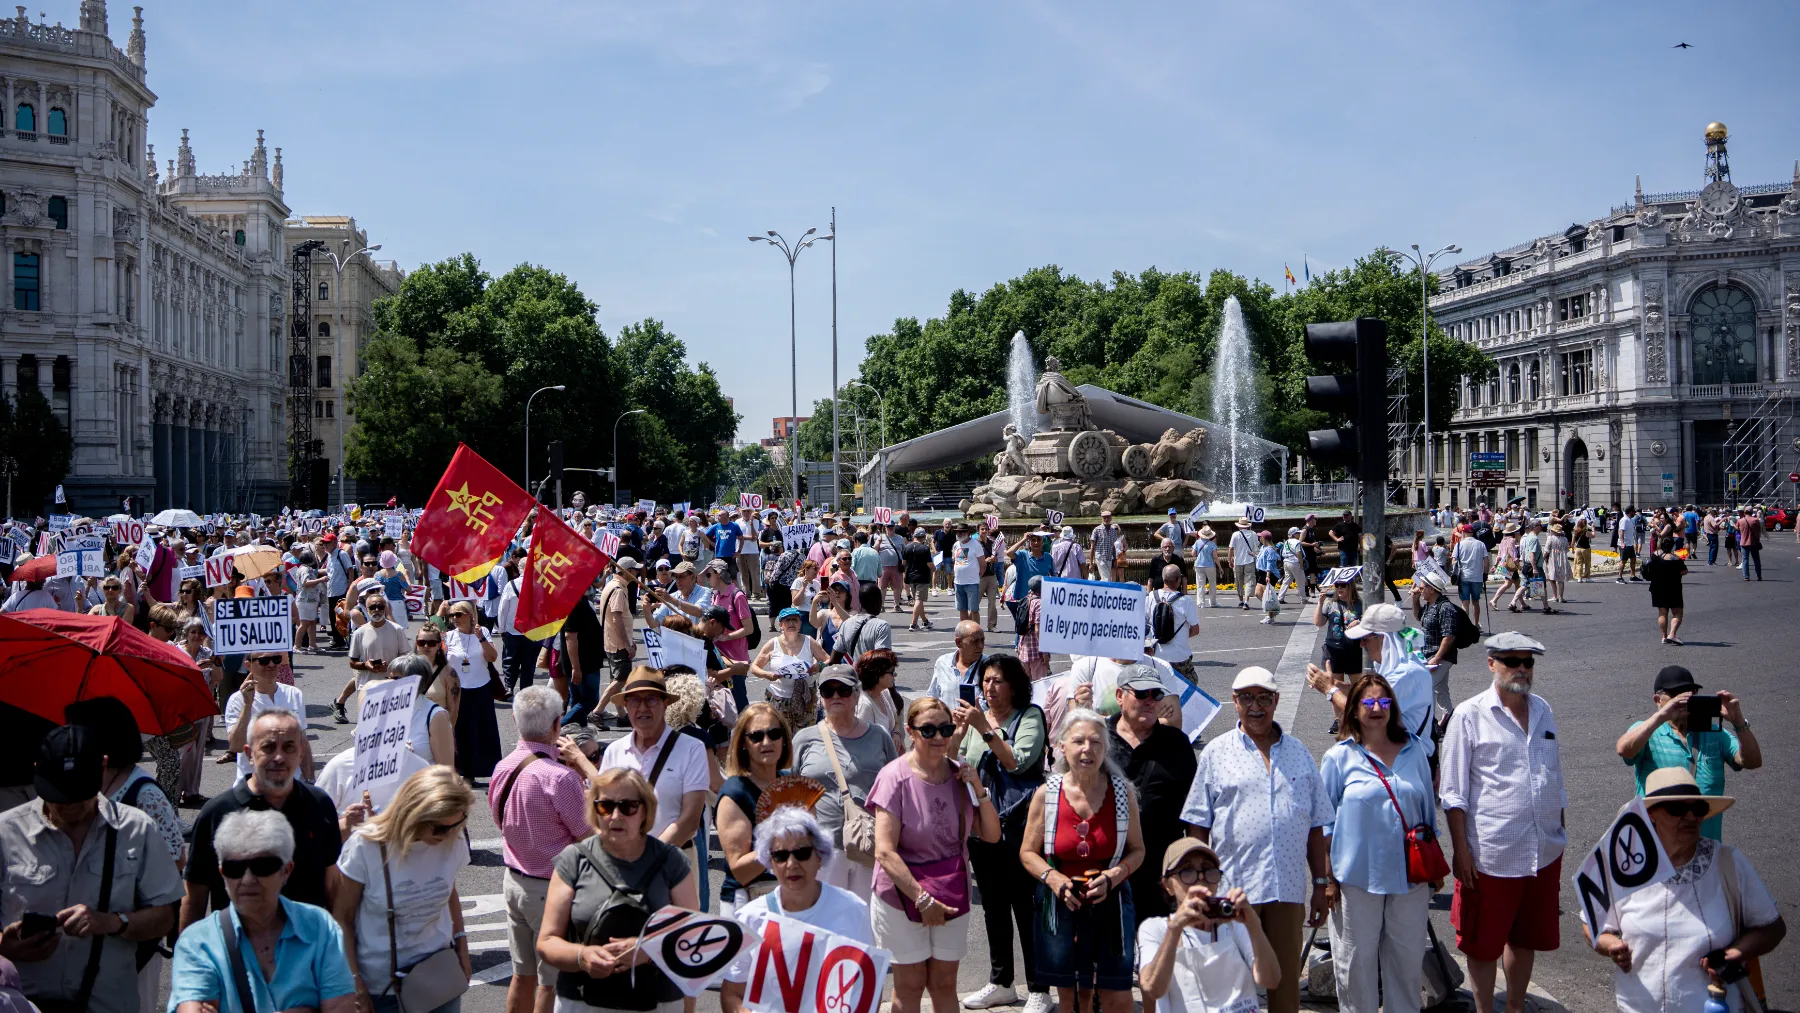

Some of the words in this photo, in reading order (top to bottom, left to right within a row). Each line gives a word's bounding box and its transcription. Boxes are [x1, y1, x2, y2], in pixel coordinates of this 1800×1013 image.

[742, 494, 761, 508] NO
[302, 519, 321, 533] NO
[874, 509, 891, 523] NO
[1246, 507, 1264, 521] NO
[117, 521, 143, 544] NO
[600, 532, 618, 555] NO
[206, 556, 234, 585] NO
[1322, 568, 1356, 586] NO
[217, 601, 235, 618] SE
[239, 598, 288, 617] VENDE
[404, 585, 425, 612] NO
[1050, 587, 1066, 606] NO
[1067, 588, 1089, 609] más
[1090, 590, 1137, 612] boicotear
[219, 624, 236, 647] TU
[240, 621, 286, 646] SALUD.
[645, 631, 660, 647] SE
[1044, 614, 1053, 633] la
[1055, 616, 1070, 640] ley
[1071, 619, 1089, 638] pro
[1090, 620, 1141, 641] pacientes.
[362, 700, 379, 722] Con
[379, 696, 389, 716] tu
[388, 686, 413, 713] salud
[357, 728, 382, 756] harán
[383, 720, 406, 749] caja
[368, 752, 398, 780] ataúd.
[1577, 812, 1659, 939] NO
[748, 919, 876, 1013] NO
